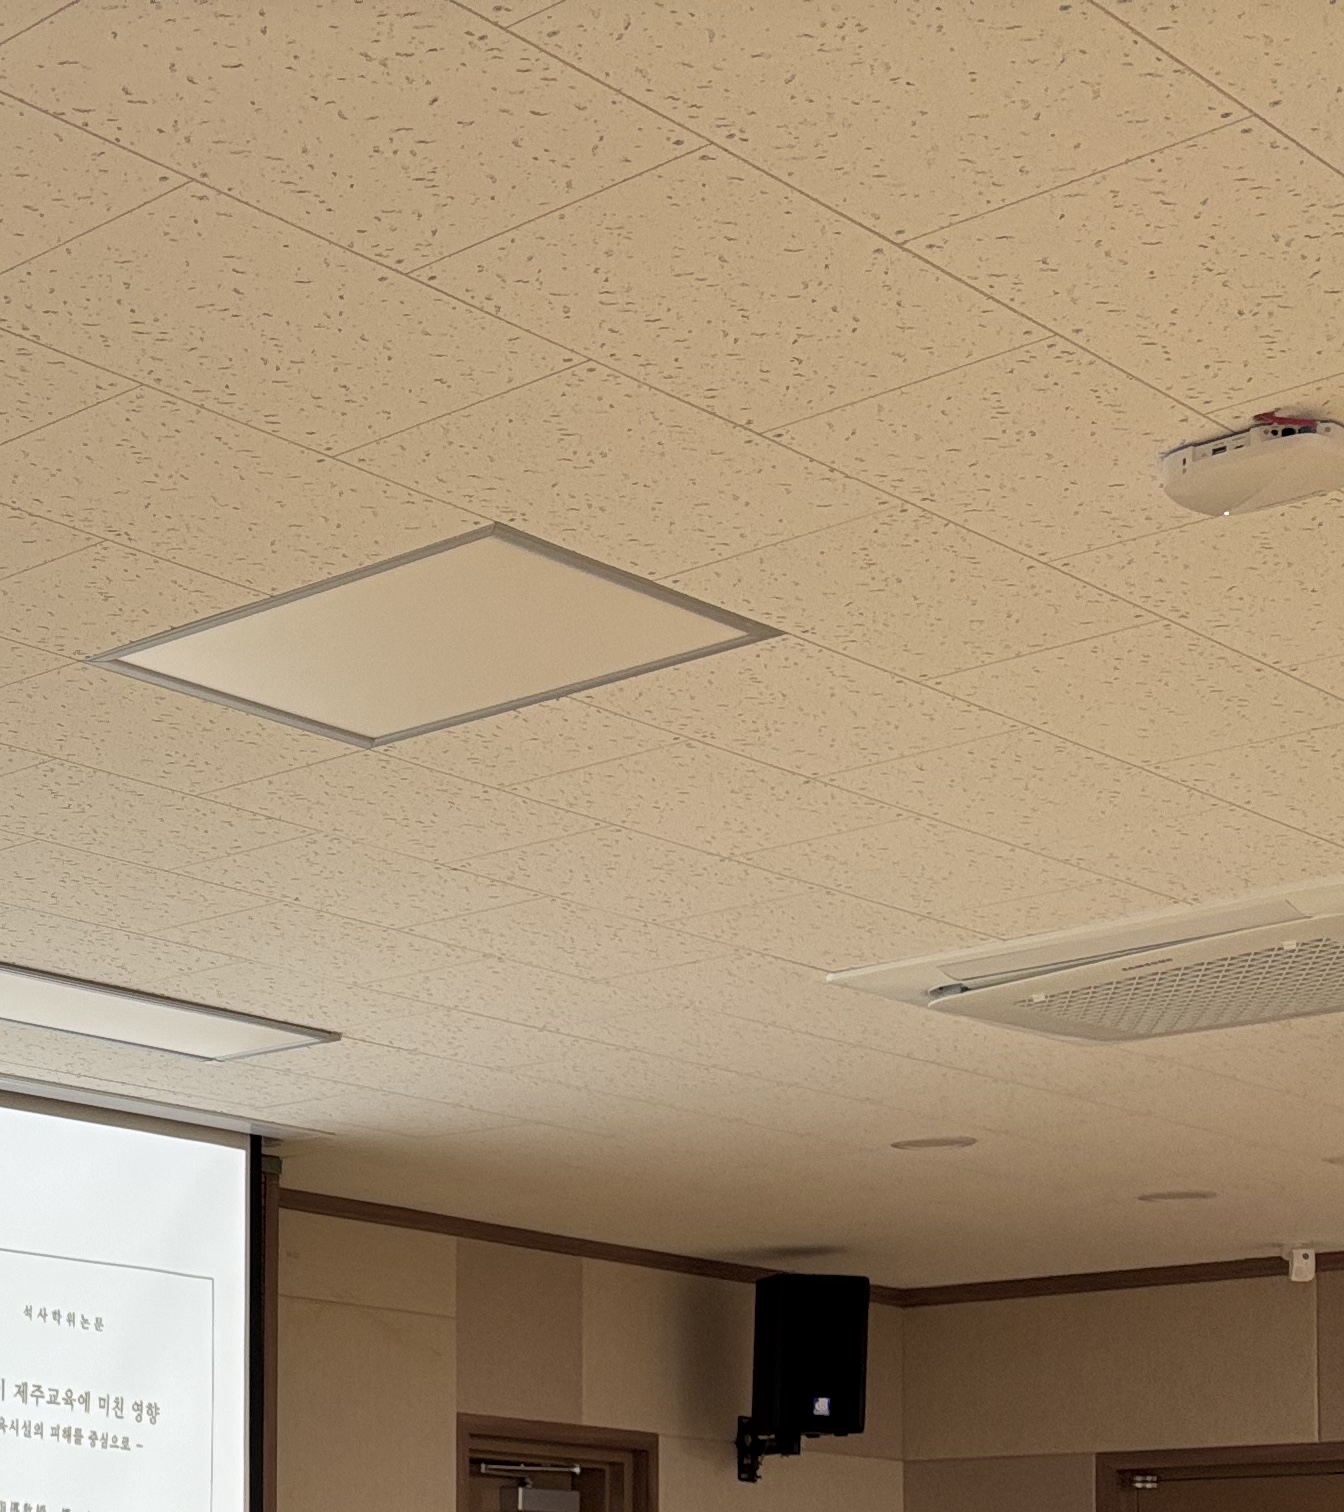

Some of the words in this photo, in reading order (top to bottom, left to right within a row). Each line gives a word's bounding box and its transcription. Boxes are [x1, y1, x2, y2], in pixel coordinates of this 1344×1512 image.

[13, 1381, 91, 1414] 제주교육에
[98, 1393, 125, 1420] 미친
[131, 1399, 161, 1426] 영향
[49, 1423, 85, 1446] 피해를
[87, 1429, 132, 1452] 중심으로
